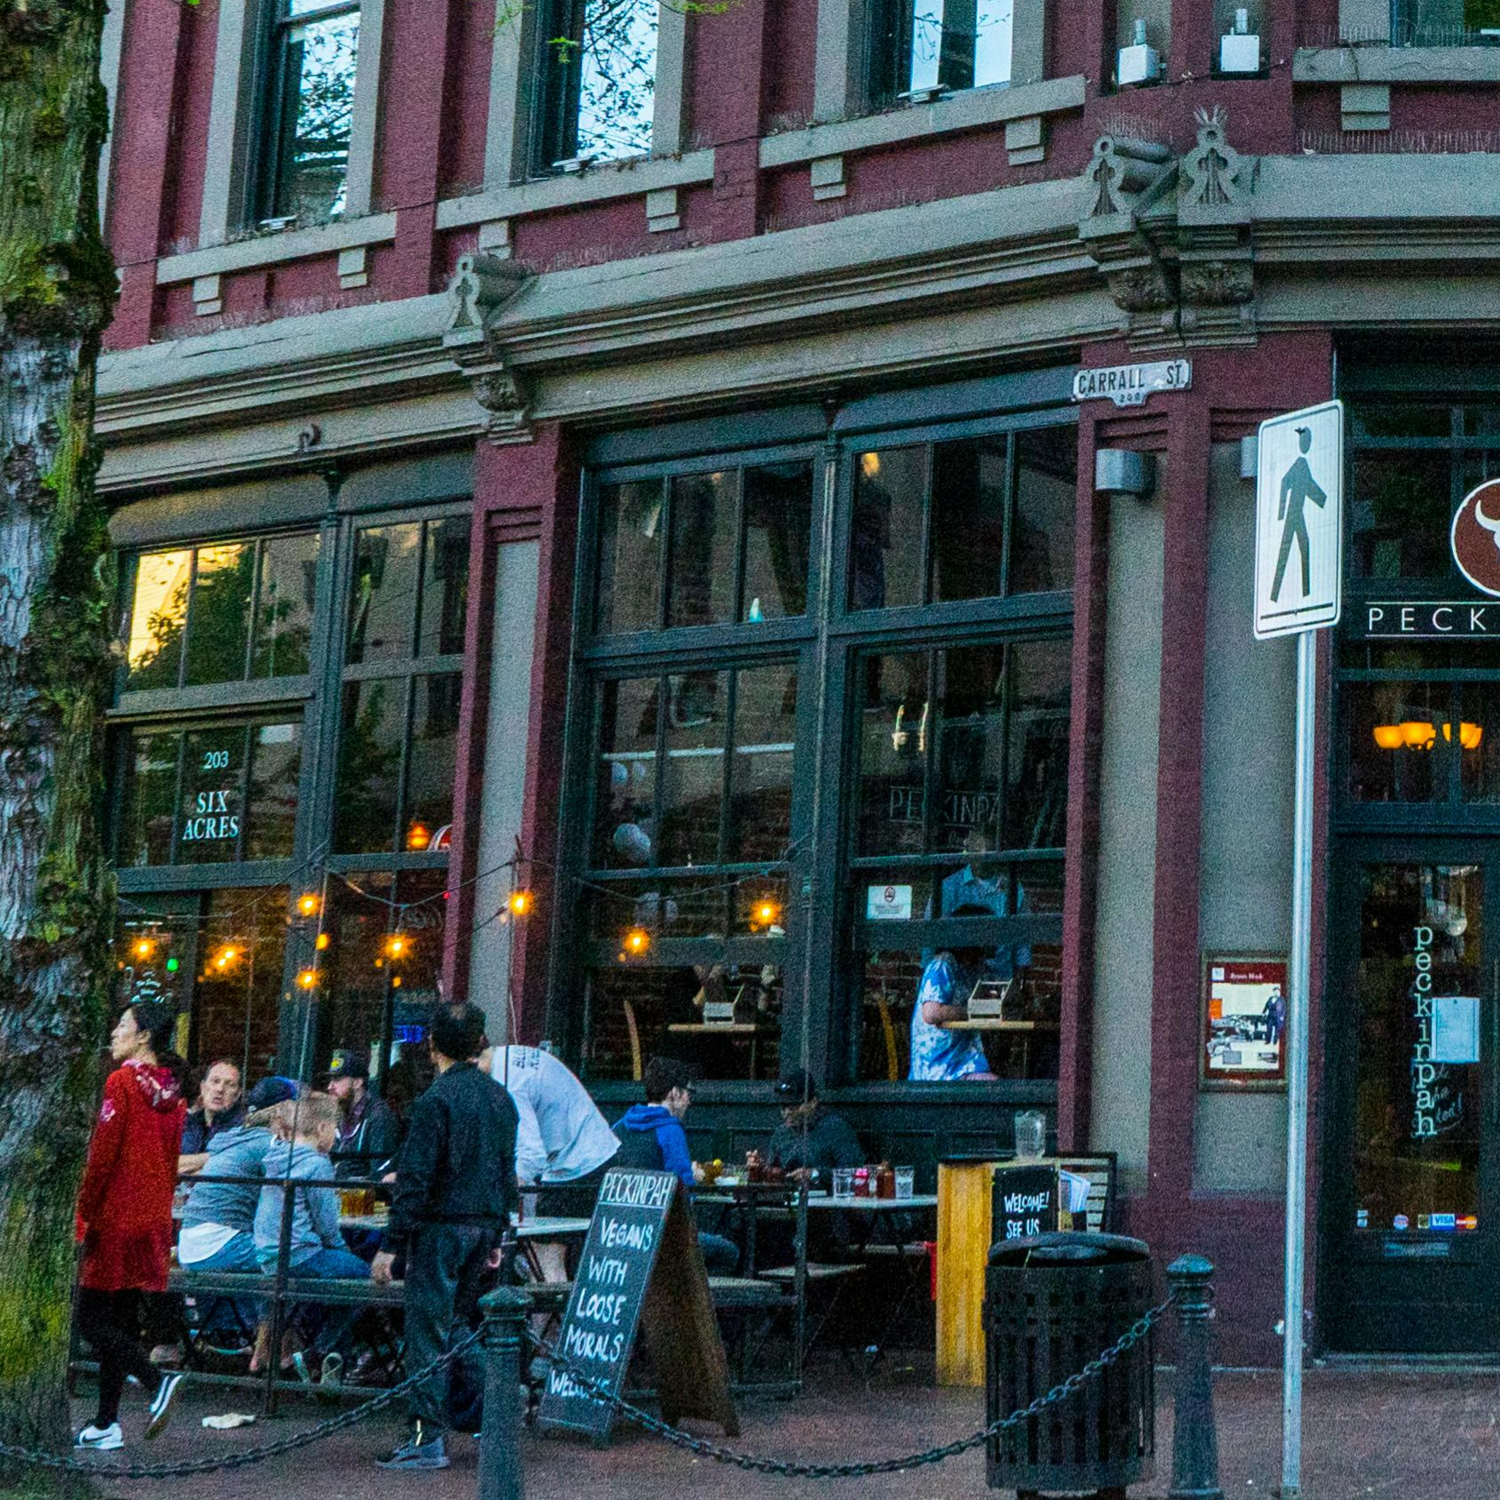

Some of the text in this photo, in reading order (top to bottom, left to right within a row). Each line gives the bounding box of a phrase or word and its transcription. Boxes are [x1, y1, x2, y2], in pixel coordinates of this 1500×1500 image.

[1078, 368, 1145, 395] CARRALL
[203, 750, 229, 770] 203
[196, 790, 230, 814] SIX
[182, 815, 240, 841] ACRES
[1413, 925, 1438, 1136] peckinpah
[600, 1172, 675, 1206] PECKINPAH
[600, 1217, 654, 1251] VEGANS
[588, 1255, 629, 1286] WITH
[575, 1287, 628, 1326] LOOSE
[564, 1323, 625, 1363] MORALS
